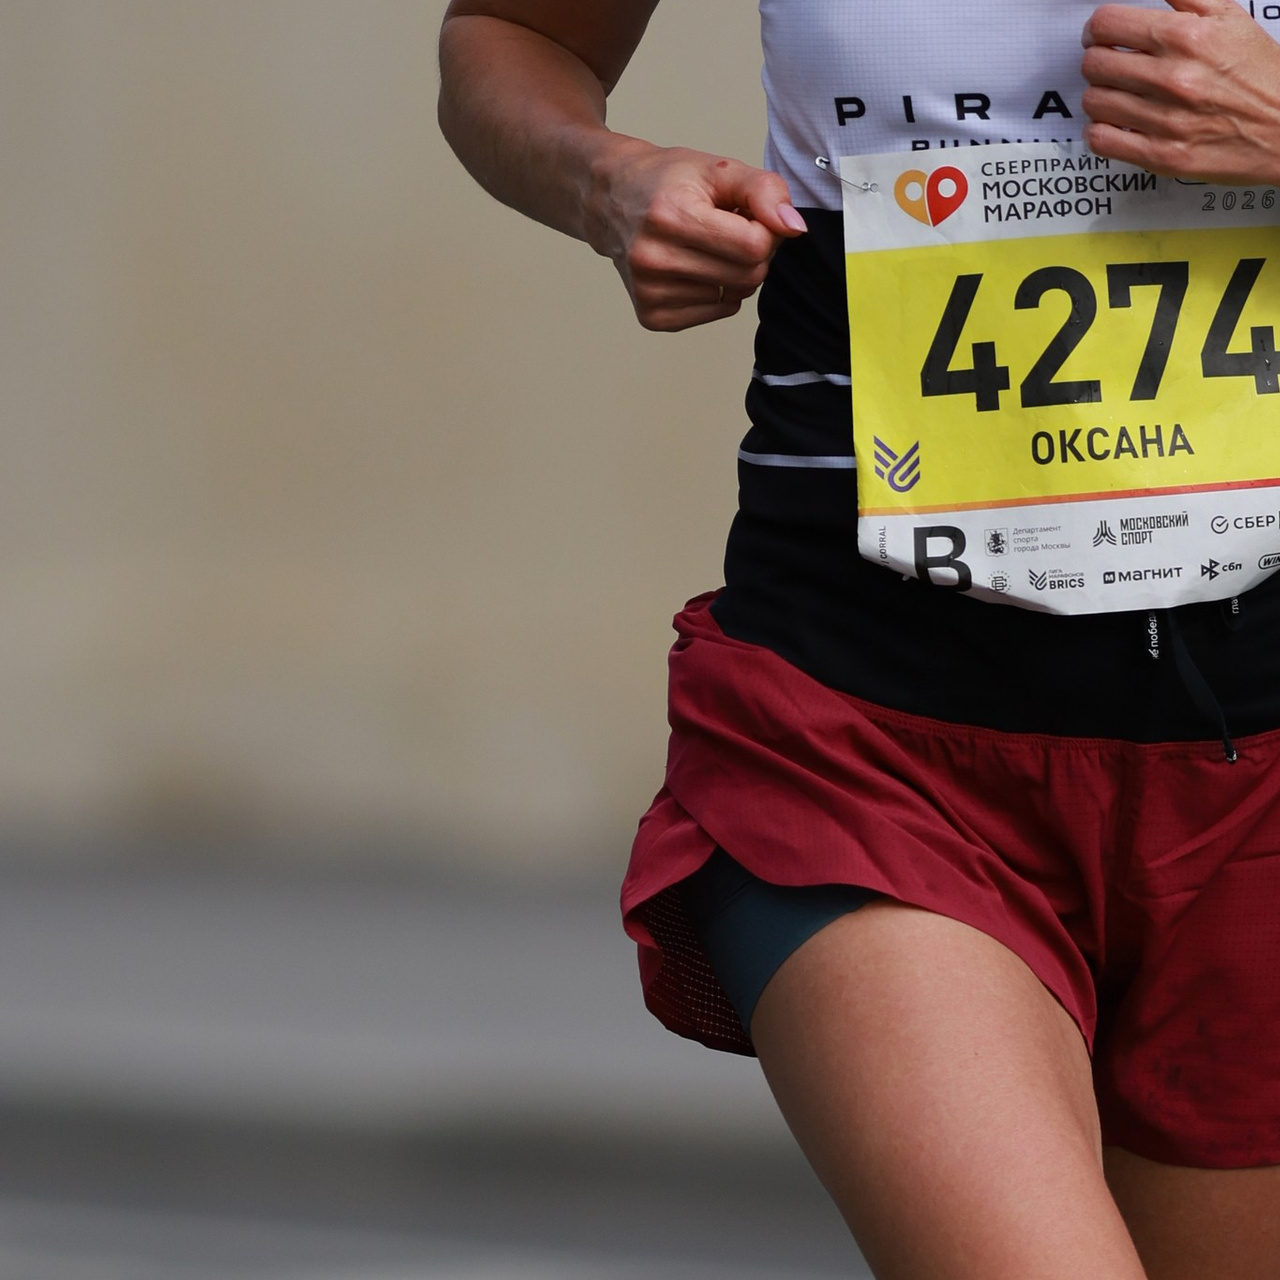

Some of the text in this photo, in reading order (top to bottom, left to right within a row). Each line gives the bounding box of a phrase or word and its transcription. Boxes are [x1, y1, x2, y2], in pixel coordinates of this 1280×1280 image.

[834, 90, 1073, 126] PIRA
[981, 154, 1110, 177] СБЕРПРАЙМ
[982, 169, 1157, 200] МОСКОВСКИЙ
[984, 197, 1112, 223] МАРАФОН
[1201, 189, 1276, 211] 2026
[1031, 423, 1195, 466] ОКСАНА
[1012, 525, 1061, 535] Департамент
[1120, 510, 1189, 531] МОСКОВСКИЙ
[1233, 515, 1276, 529] СБЕР
[879, 525, 888, 559] CORRAL
[1013, 536, 1039, 544] спорта
[1013, 542, 1071, 553] города Москвы
[1121, 530, 1153, 546] СПОРТ
[913, 525, 973, 592] B
[1049, 578, 1085, 590] BRICS
[1231, 597, 1240, 614] гла
